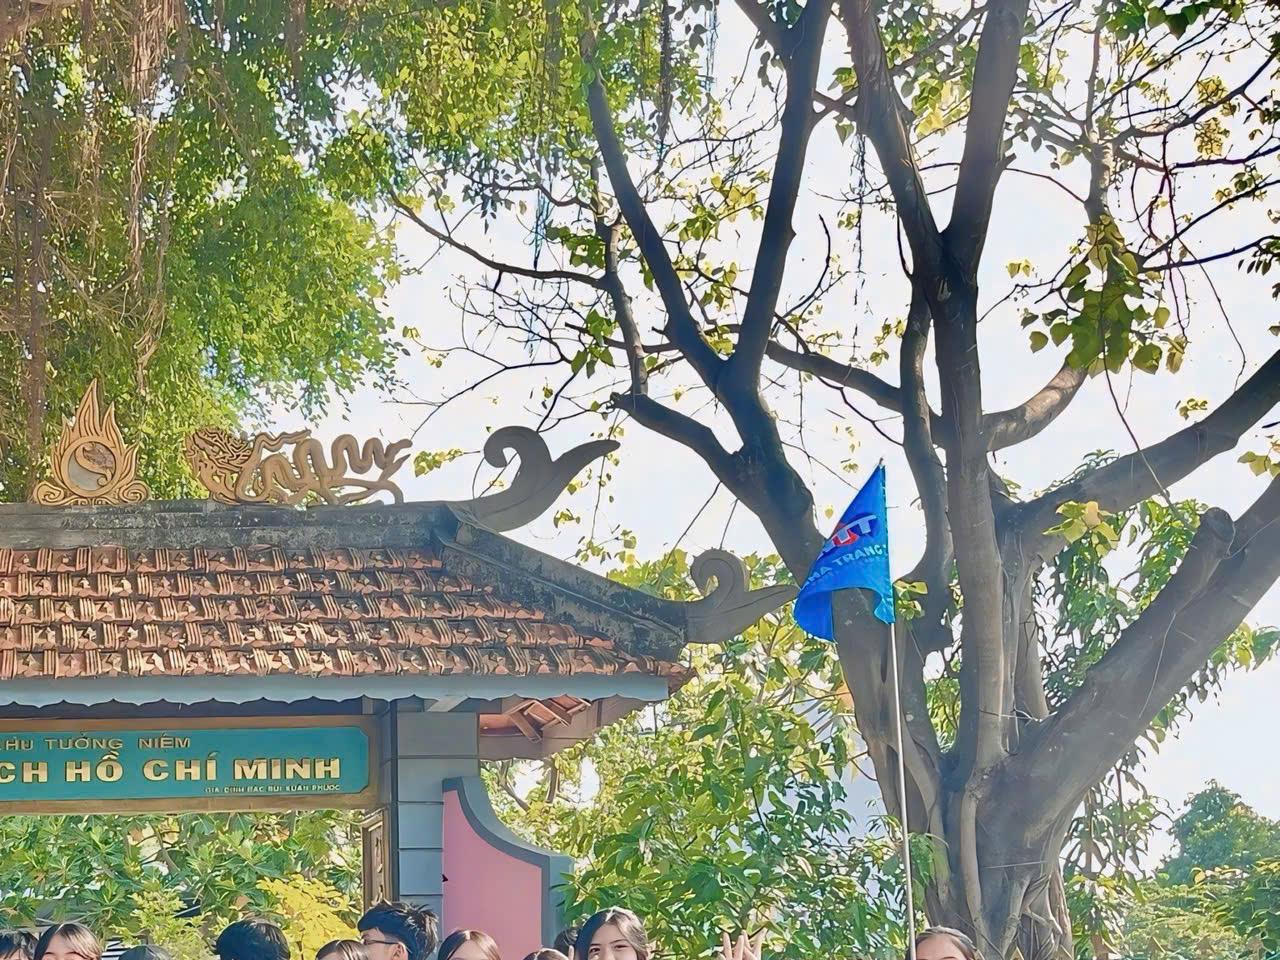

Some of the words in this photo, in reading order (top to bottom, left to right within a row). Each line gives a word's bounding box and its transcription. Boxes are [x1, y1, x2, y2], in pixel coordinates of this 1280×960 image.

[66, 751, 122, 782] HỒ
[143, 752, 218, 781] CHÍ
[234, 758, 340, 780] MINH
